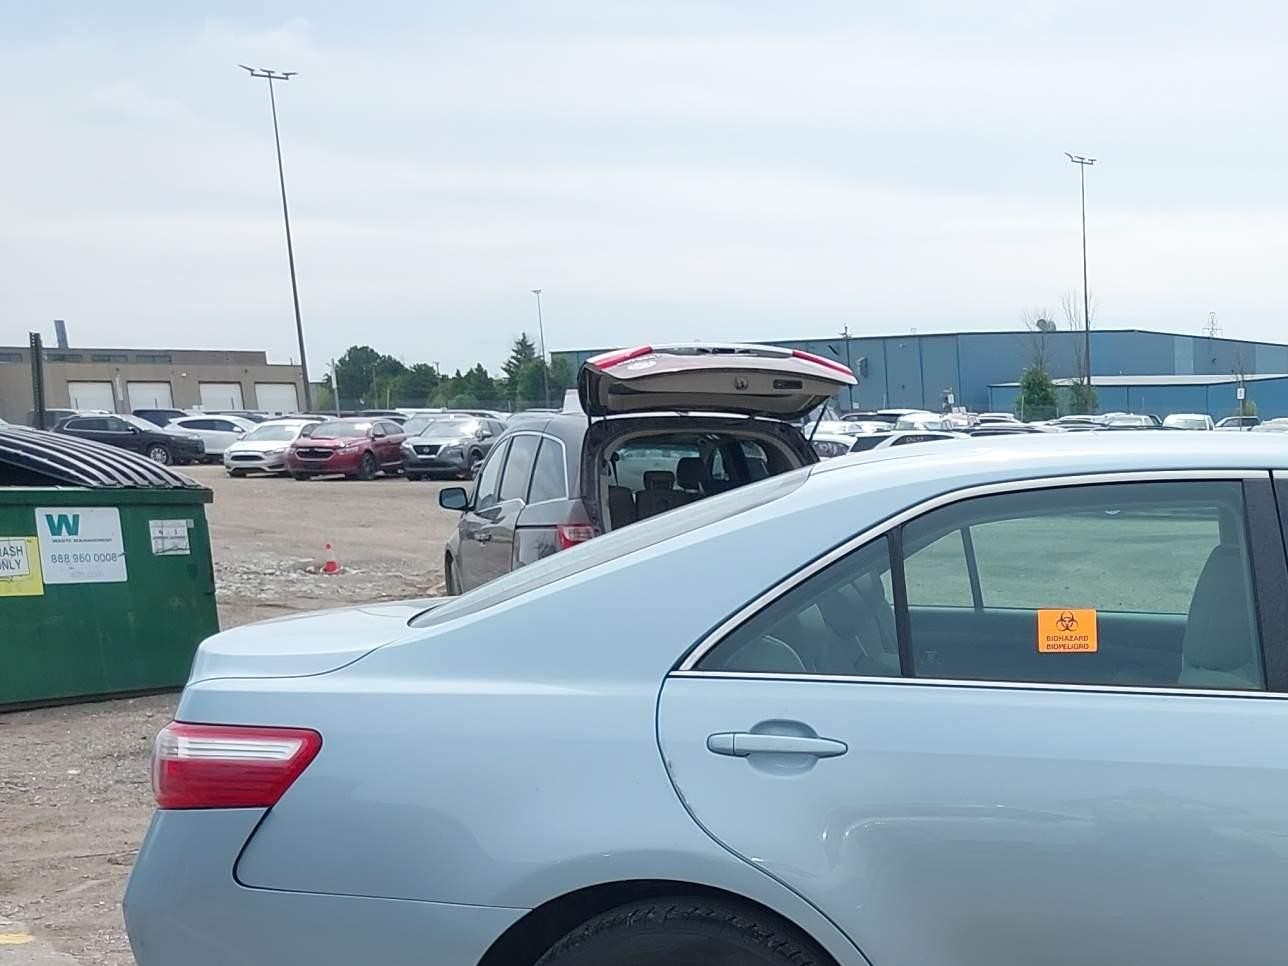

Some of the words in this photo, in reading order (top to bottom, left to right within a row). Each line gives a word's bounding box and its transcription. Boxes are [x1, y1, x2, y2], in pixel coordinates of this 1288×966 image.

[0, 545, 24, 557] ASH
[51, 553, 70, 564] 888
[72, 553, 92, 563] 960
[93, 552, 117, 562] 0008
[0, 559, 21, 571] NLY
